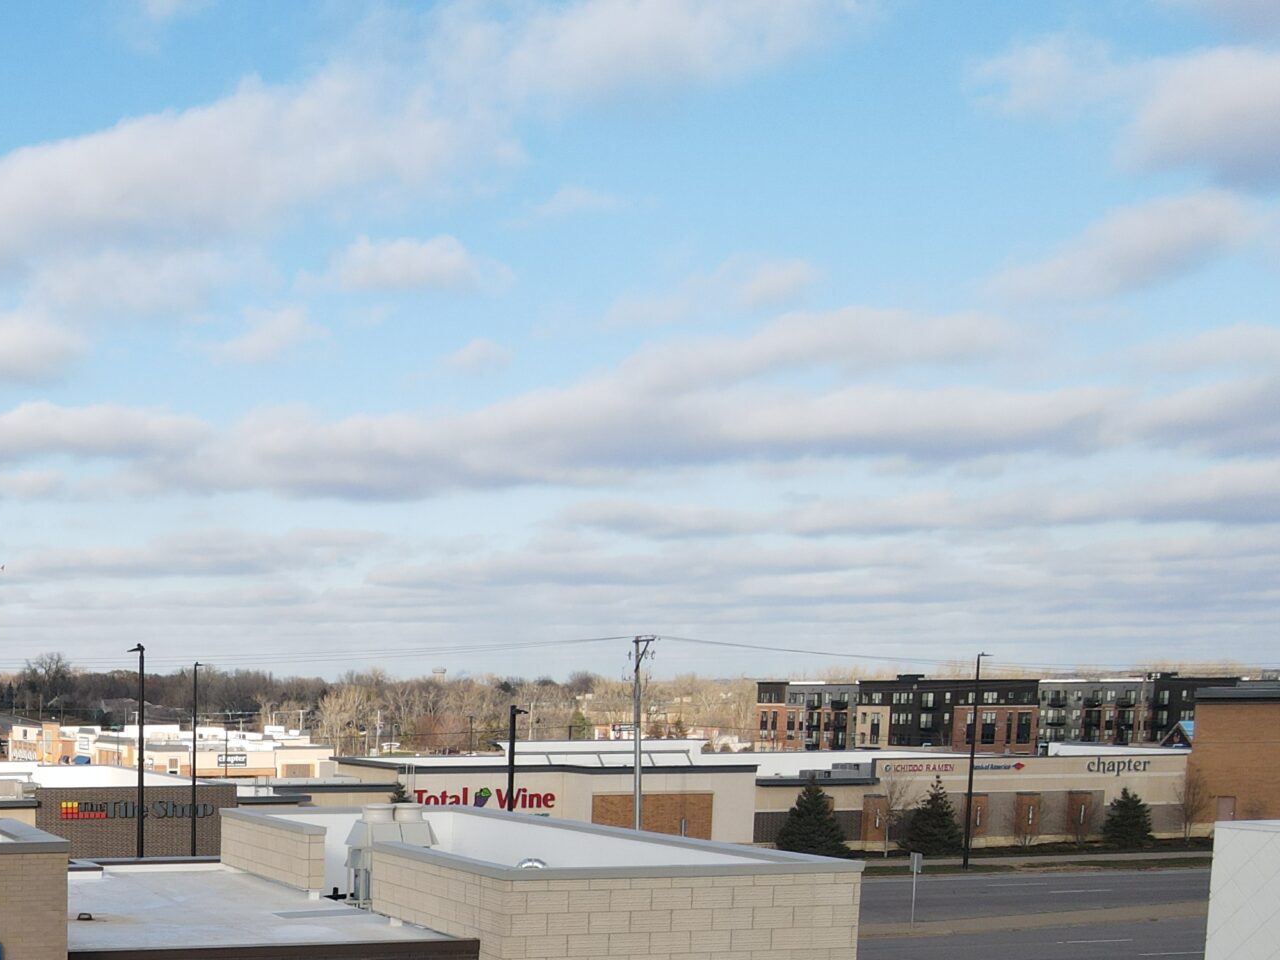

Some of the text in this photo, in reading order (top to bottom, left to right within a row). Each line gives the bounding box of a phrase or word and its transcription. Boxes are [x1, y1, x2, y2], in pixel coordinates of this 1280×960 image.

[925, 763, 955, 772] RAMEN
[1086, 757, 1151, 776] chapter
[413, 787, 556, 809] Total Wine
